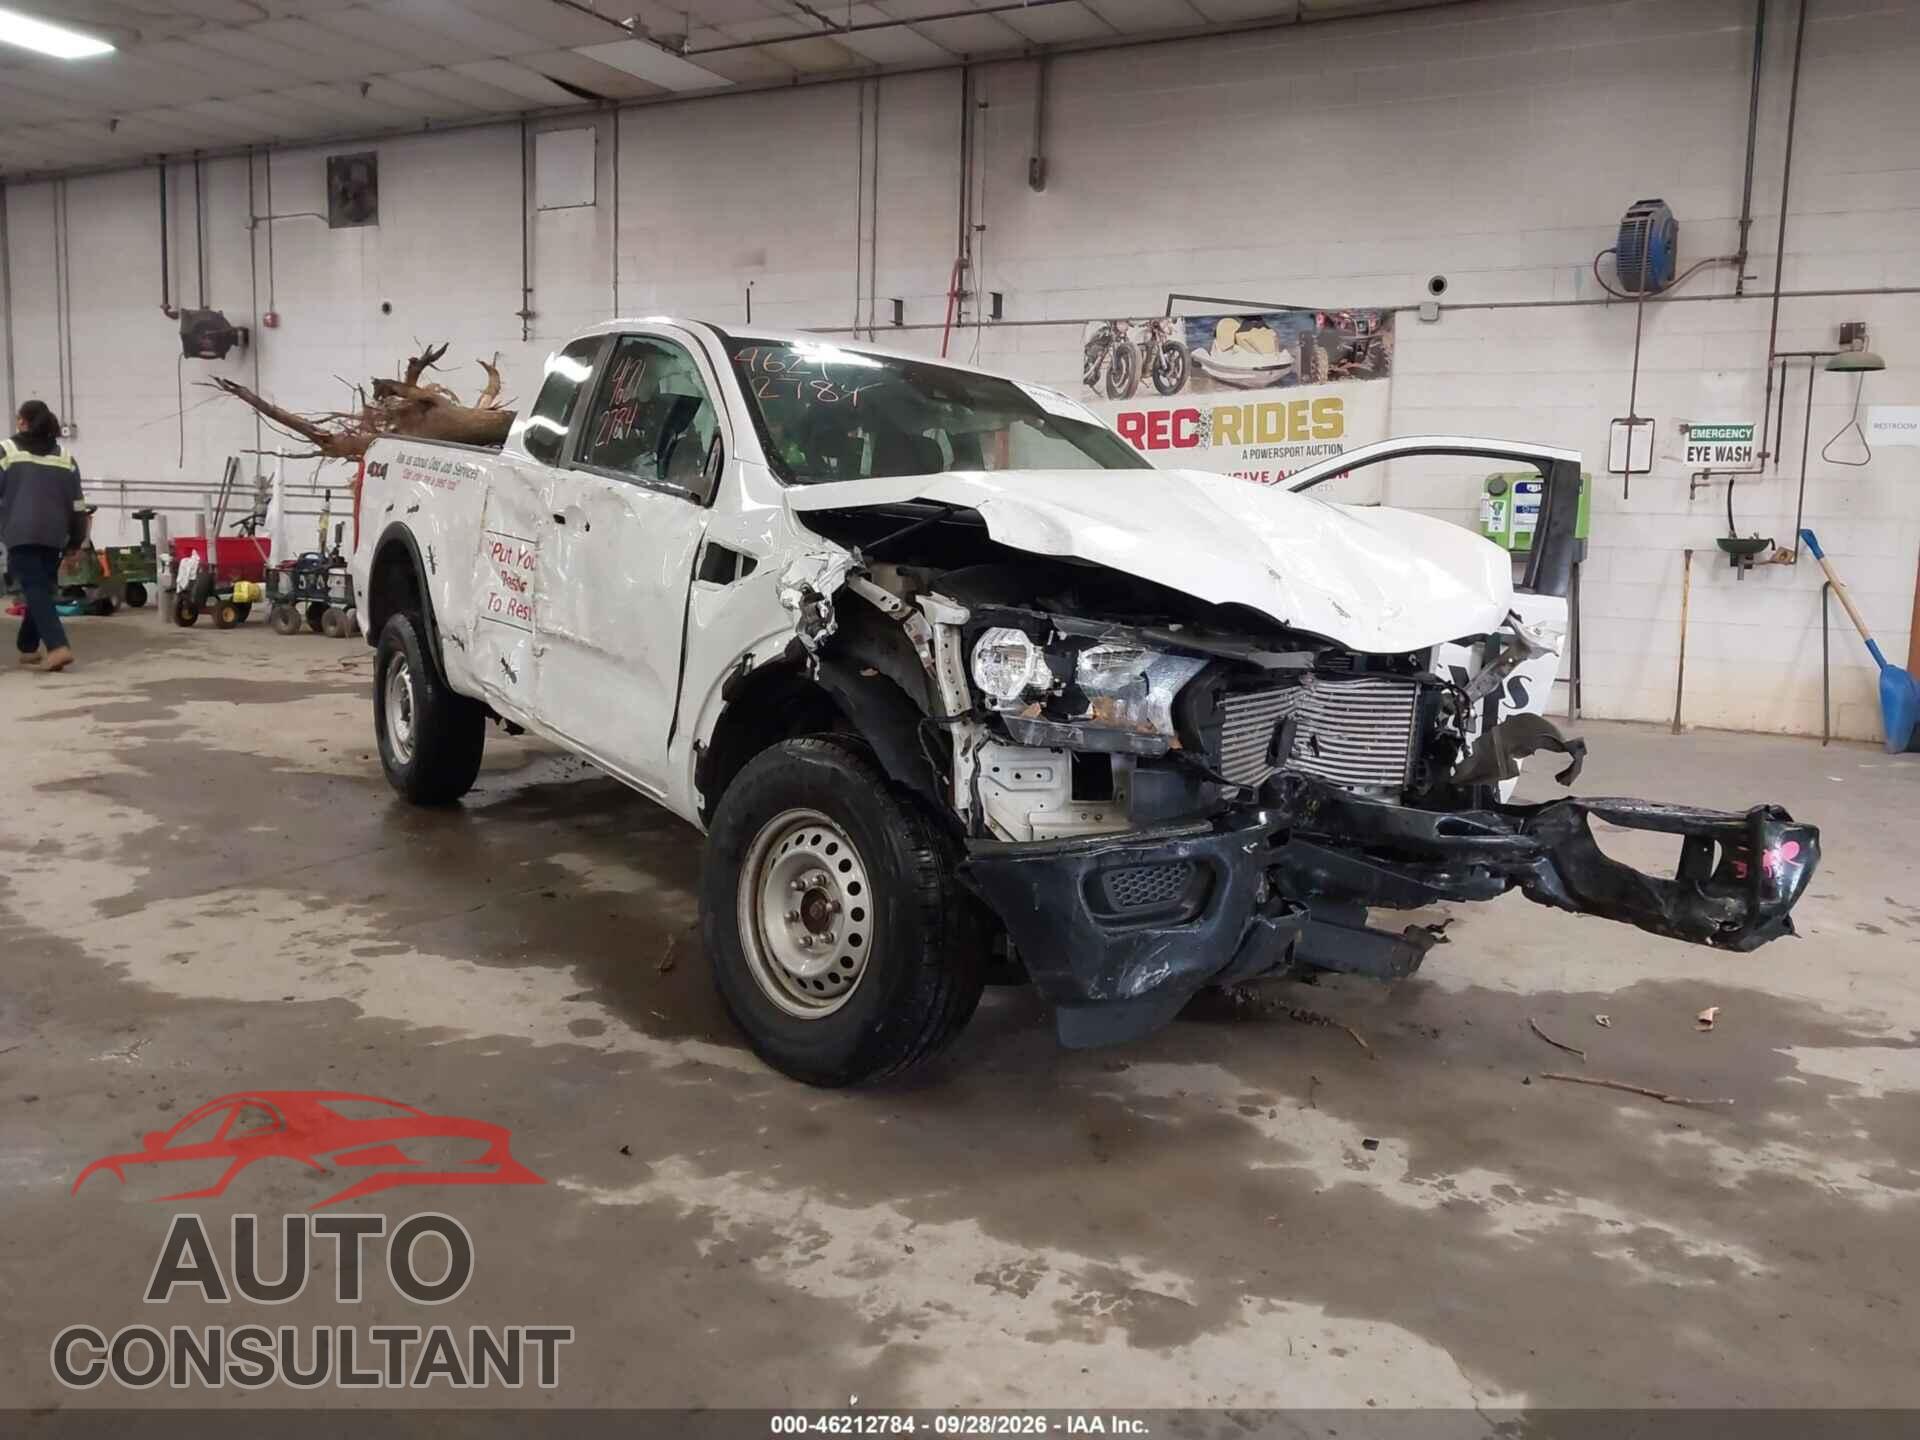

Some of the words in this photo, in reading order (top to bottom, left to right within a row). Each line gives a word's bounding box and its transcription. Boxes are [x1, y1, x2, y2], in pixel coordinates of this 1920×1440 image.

[1117, 408, 1200, 450] REC
[1212, 398, 1344, 446] RIDES
[1690, 427, 1753, 440] EMERGENCY
[1242, 450, 1249, 460] A
[1250, 446, 1304, 460] POWERSPORT
[1306, 443, 1344, 456] AUCTION
[1687, 446, 1711, 462] EYE
[1715, 446, 1752, 463] WASH
[488, 592, 502, 612] To
